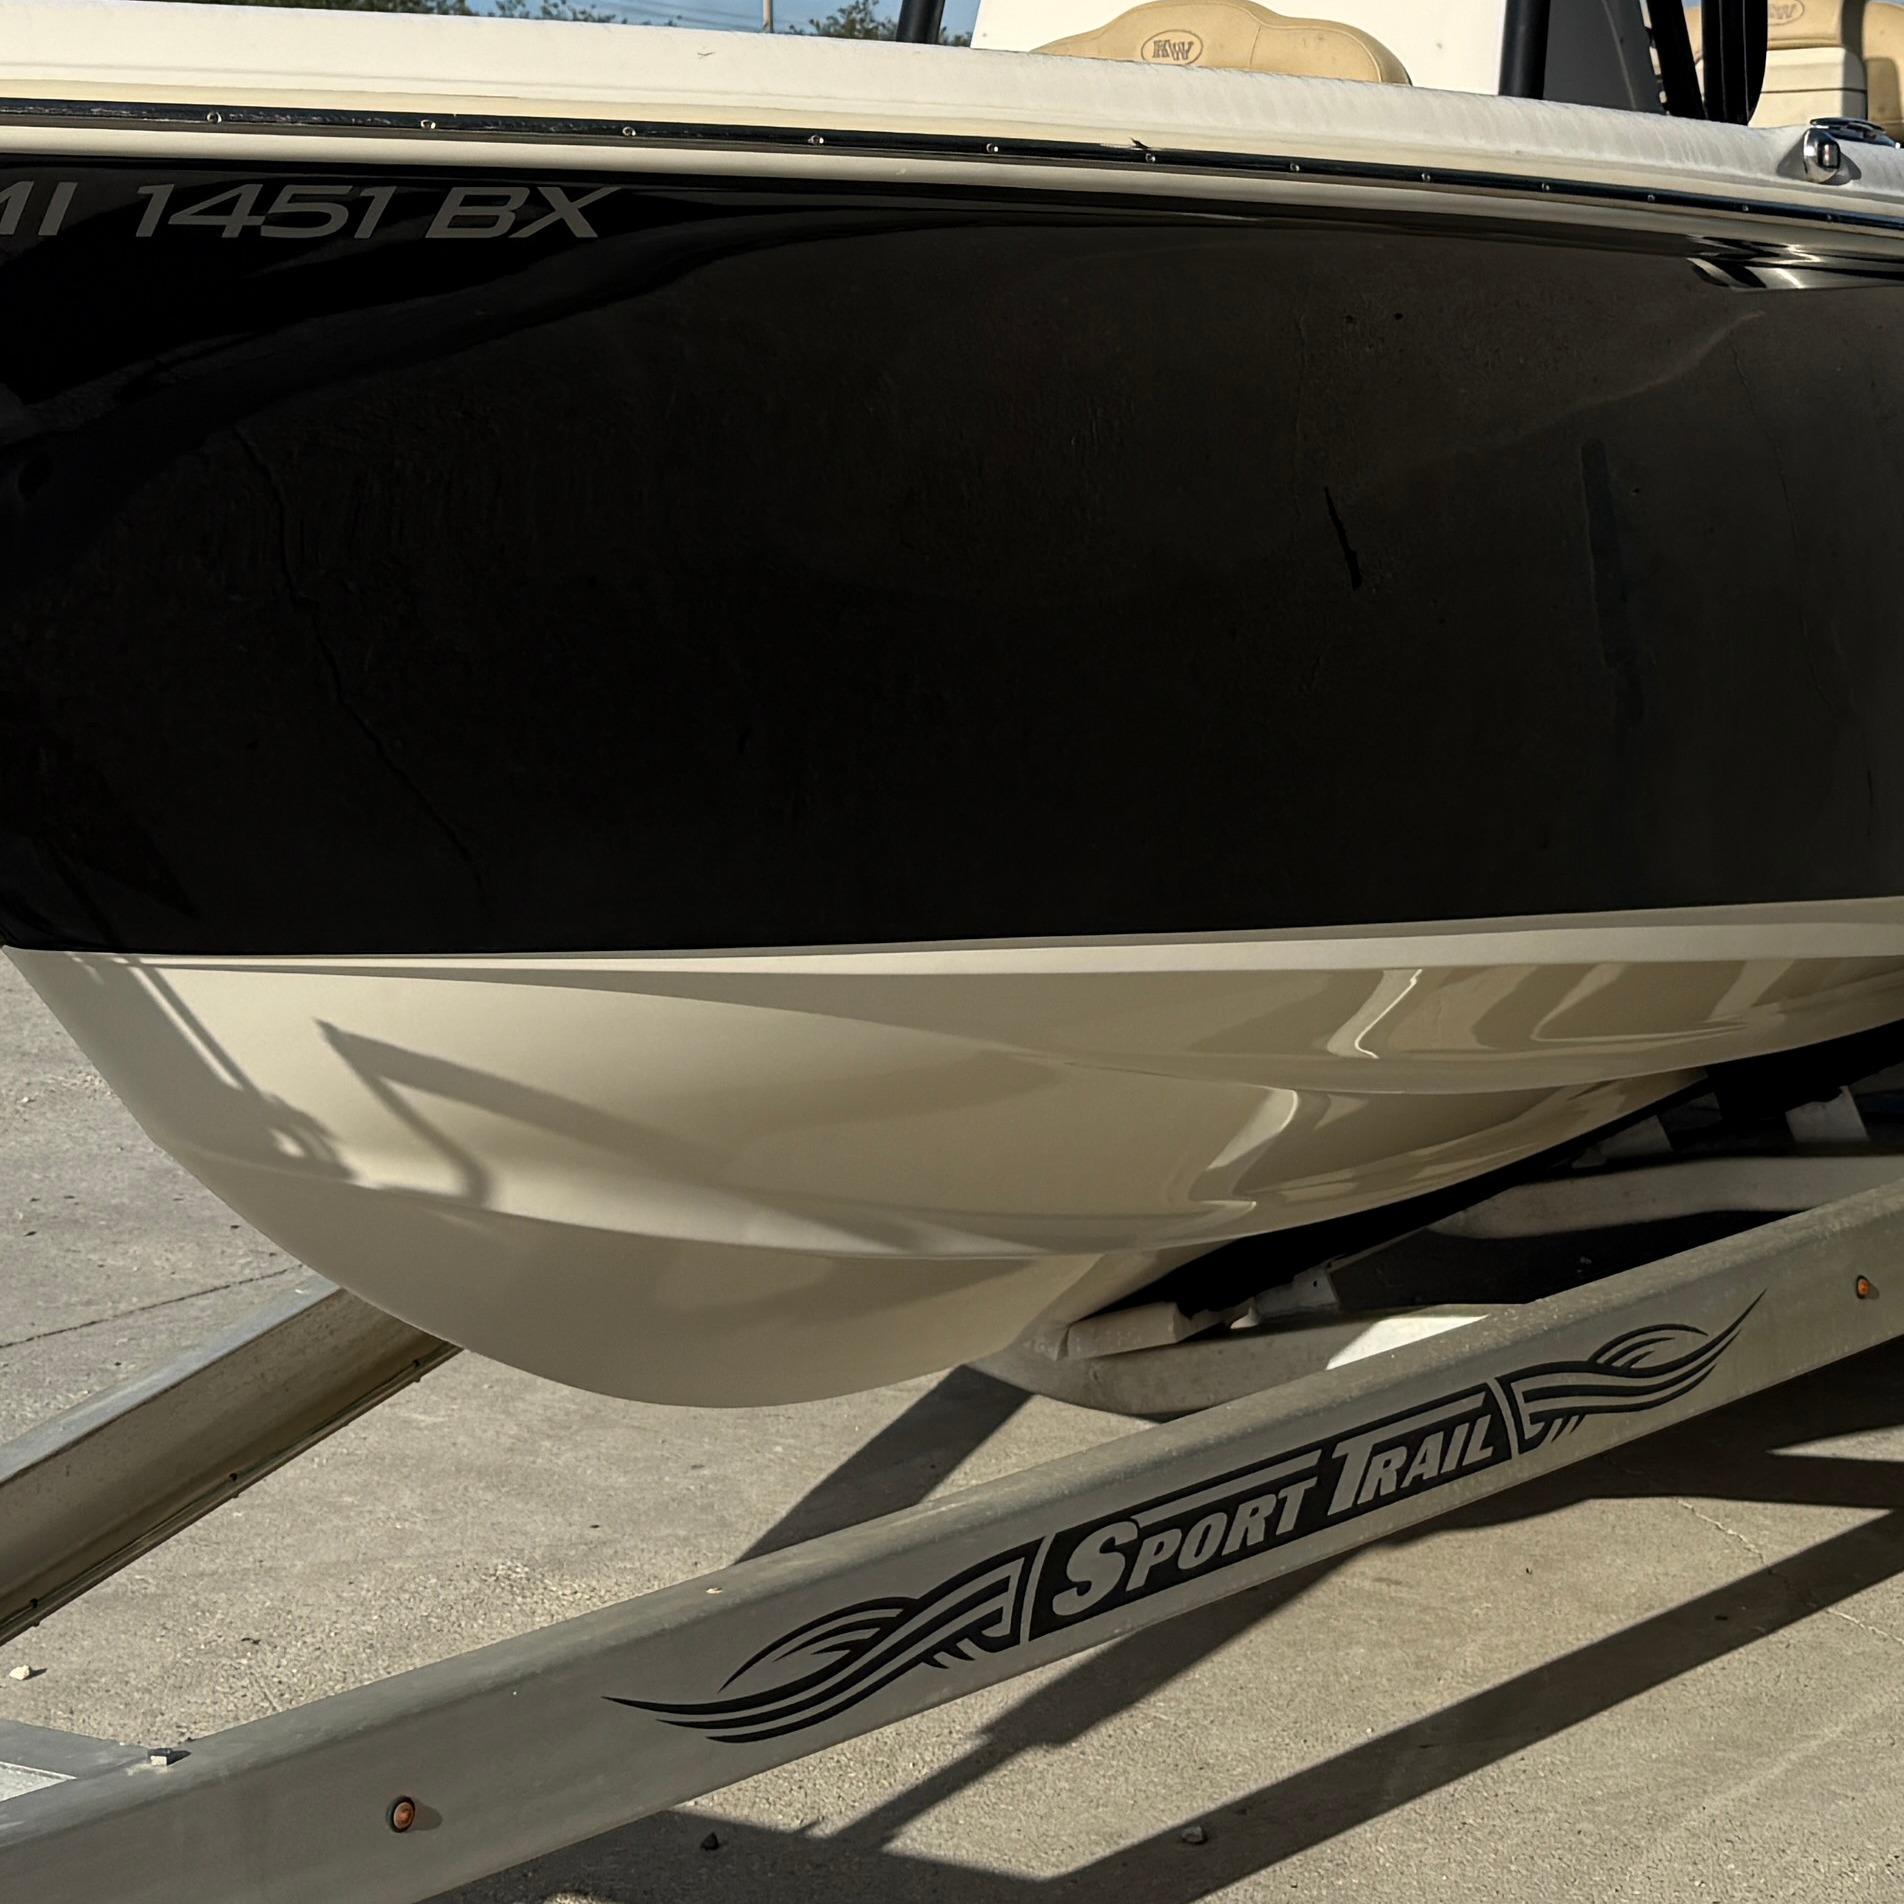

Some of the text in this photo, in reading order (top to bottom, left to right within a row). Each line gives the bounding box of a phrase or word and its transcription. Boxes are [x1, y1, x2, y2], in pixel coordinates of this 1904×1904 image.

[1152, 39, 1194, 61] KW
[136, 183, 397, 239] 1451
[426, 186, 622, 239] BX
[1052, 1393, 1496, 1617] SPORT TRAIL
